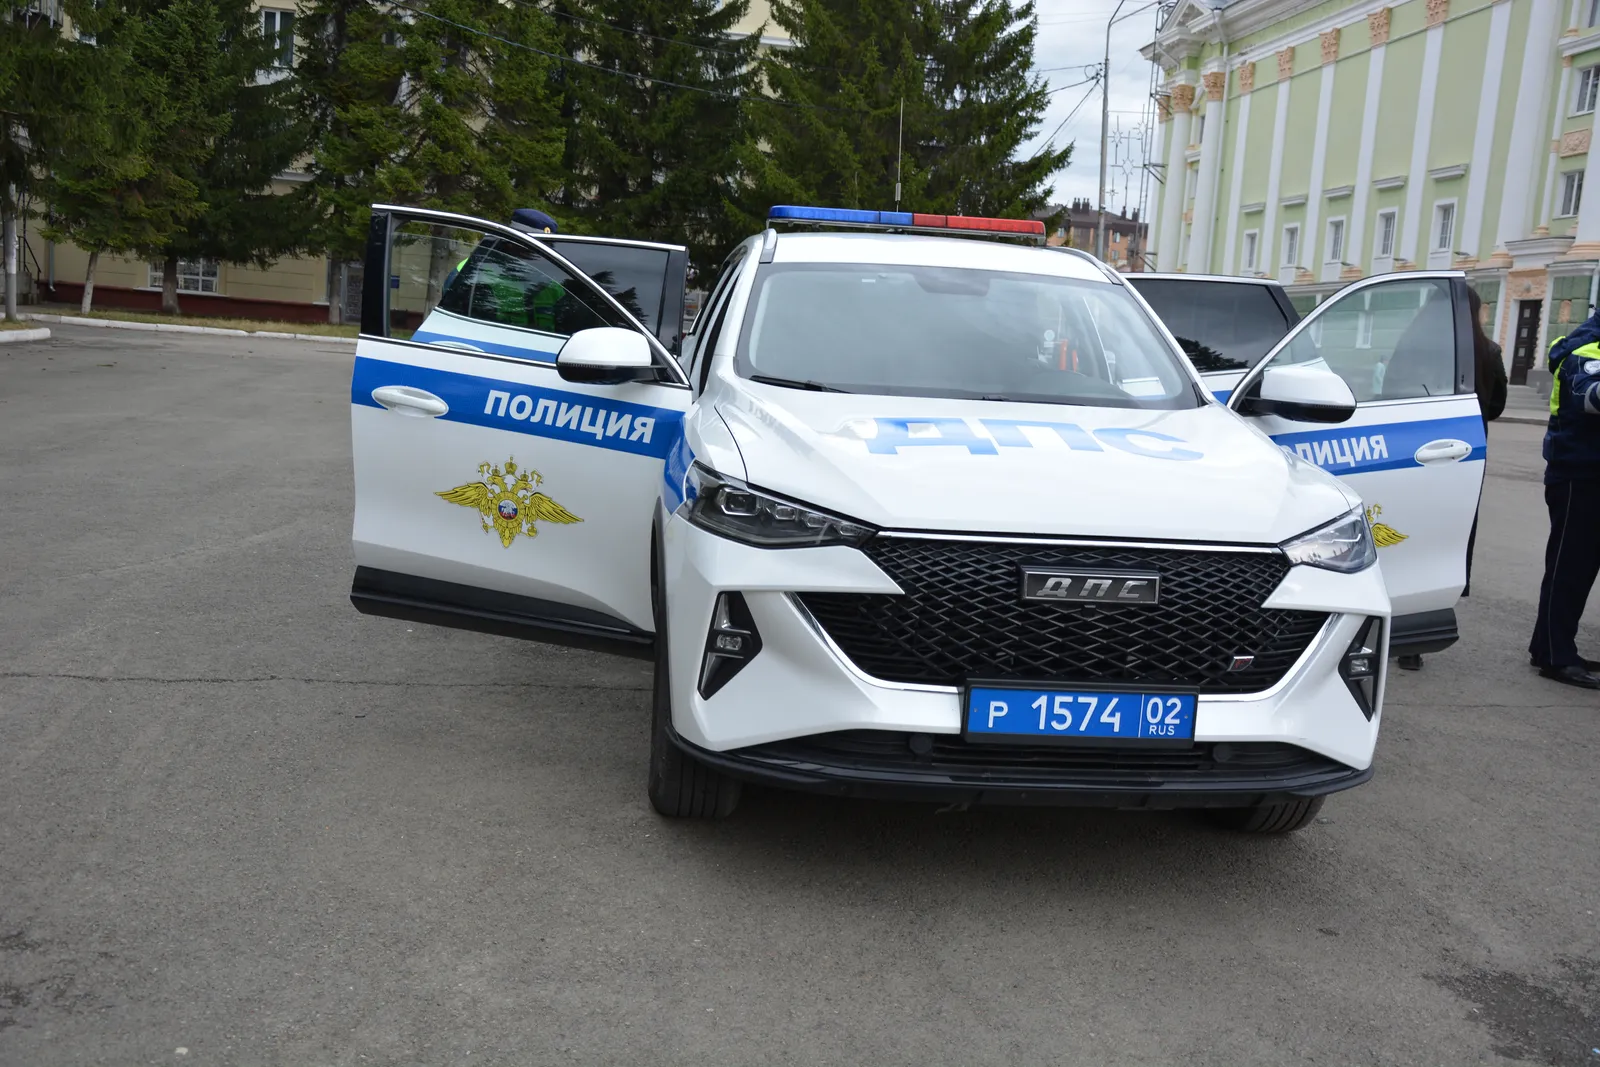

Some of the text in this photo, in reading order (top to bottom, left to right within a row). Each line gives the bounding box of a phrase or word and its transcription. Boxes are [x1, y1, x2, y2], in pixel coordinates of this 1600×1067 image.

[483, 389, 656, 444] ПОЛИЦИЯ
[864, 417, 1205, 461] ДПС
[1280, 434, 1389, 468] ЛИЦИЯ
[1036, 577, 1148, 598] ДПС
[987, 695, 1182, 733] Р 1574 02
[1149, 725, 1175, 736] RUS
